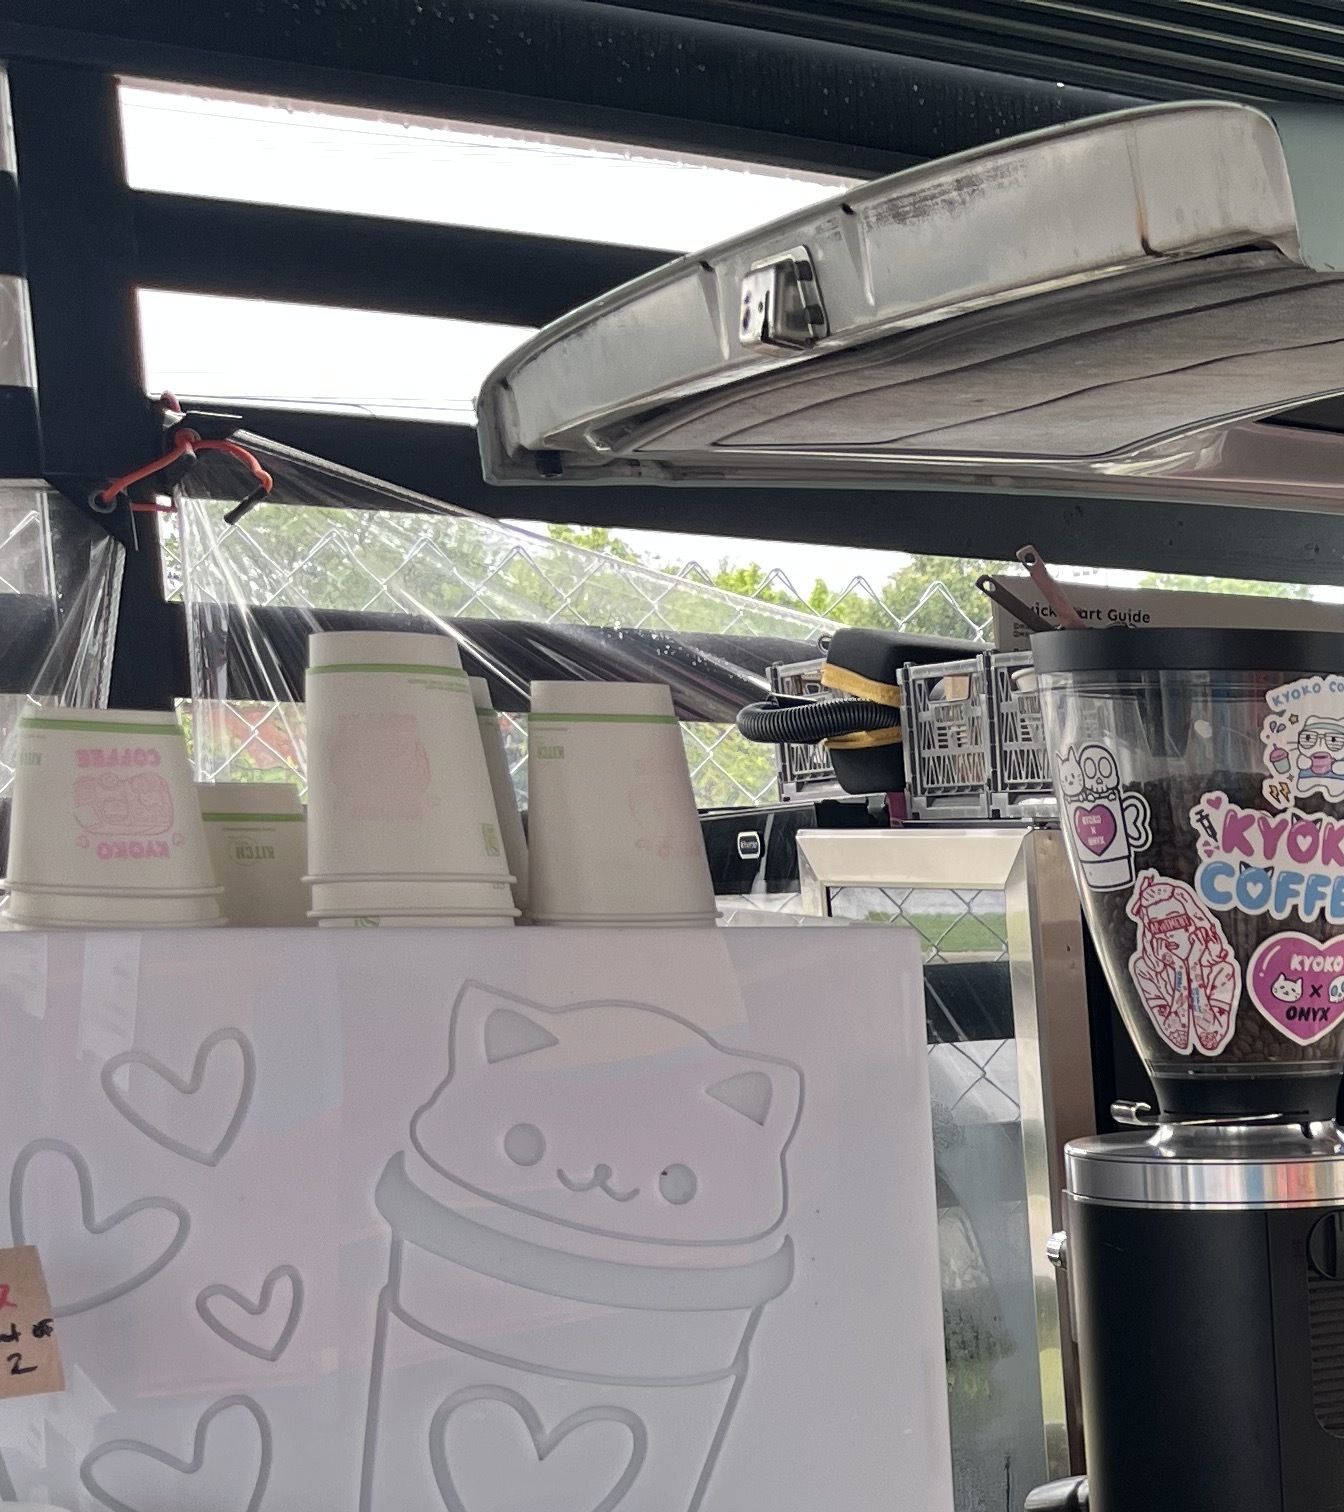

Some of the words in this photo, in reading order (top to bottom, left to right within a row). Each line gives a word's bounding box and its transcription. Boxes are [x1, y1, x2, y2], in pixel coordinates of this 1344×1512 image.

[1031, 602, 1058, 618] ick
[1108, 608, 1151, 624] Guide
[1271, 680, 1321, 707] KYOKO
[1289, 954, 1344, 973] KYOKO
[1285, 1004, 1331, 1022] ONYX
